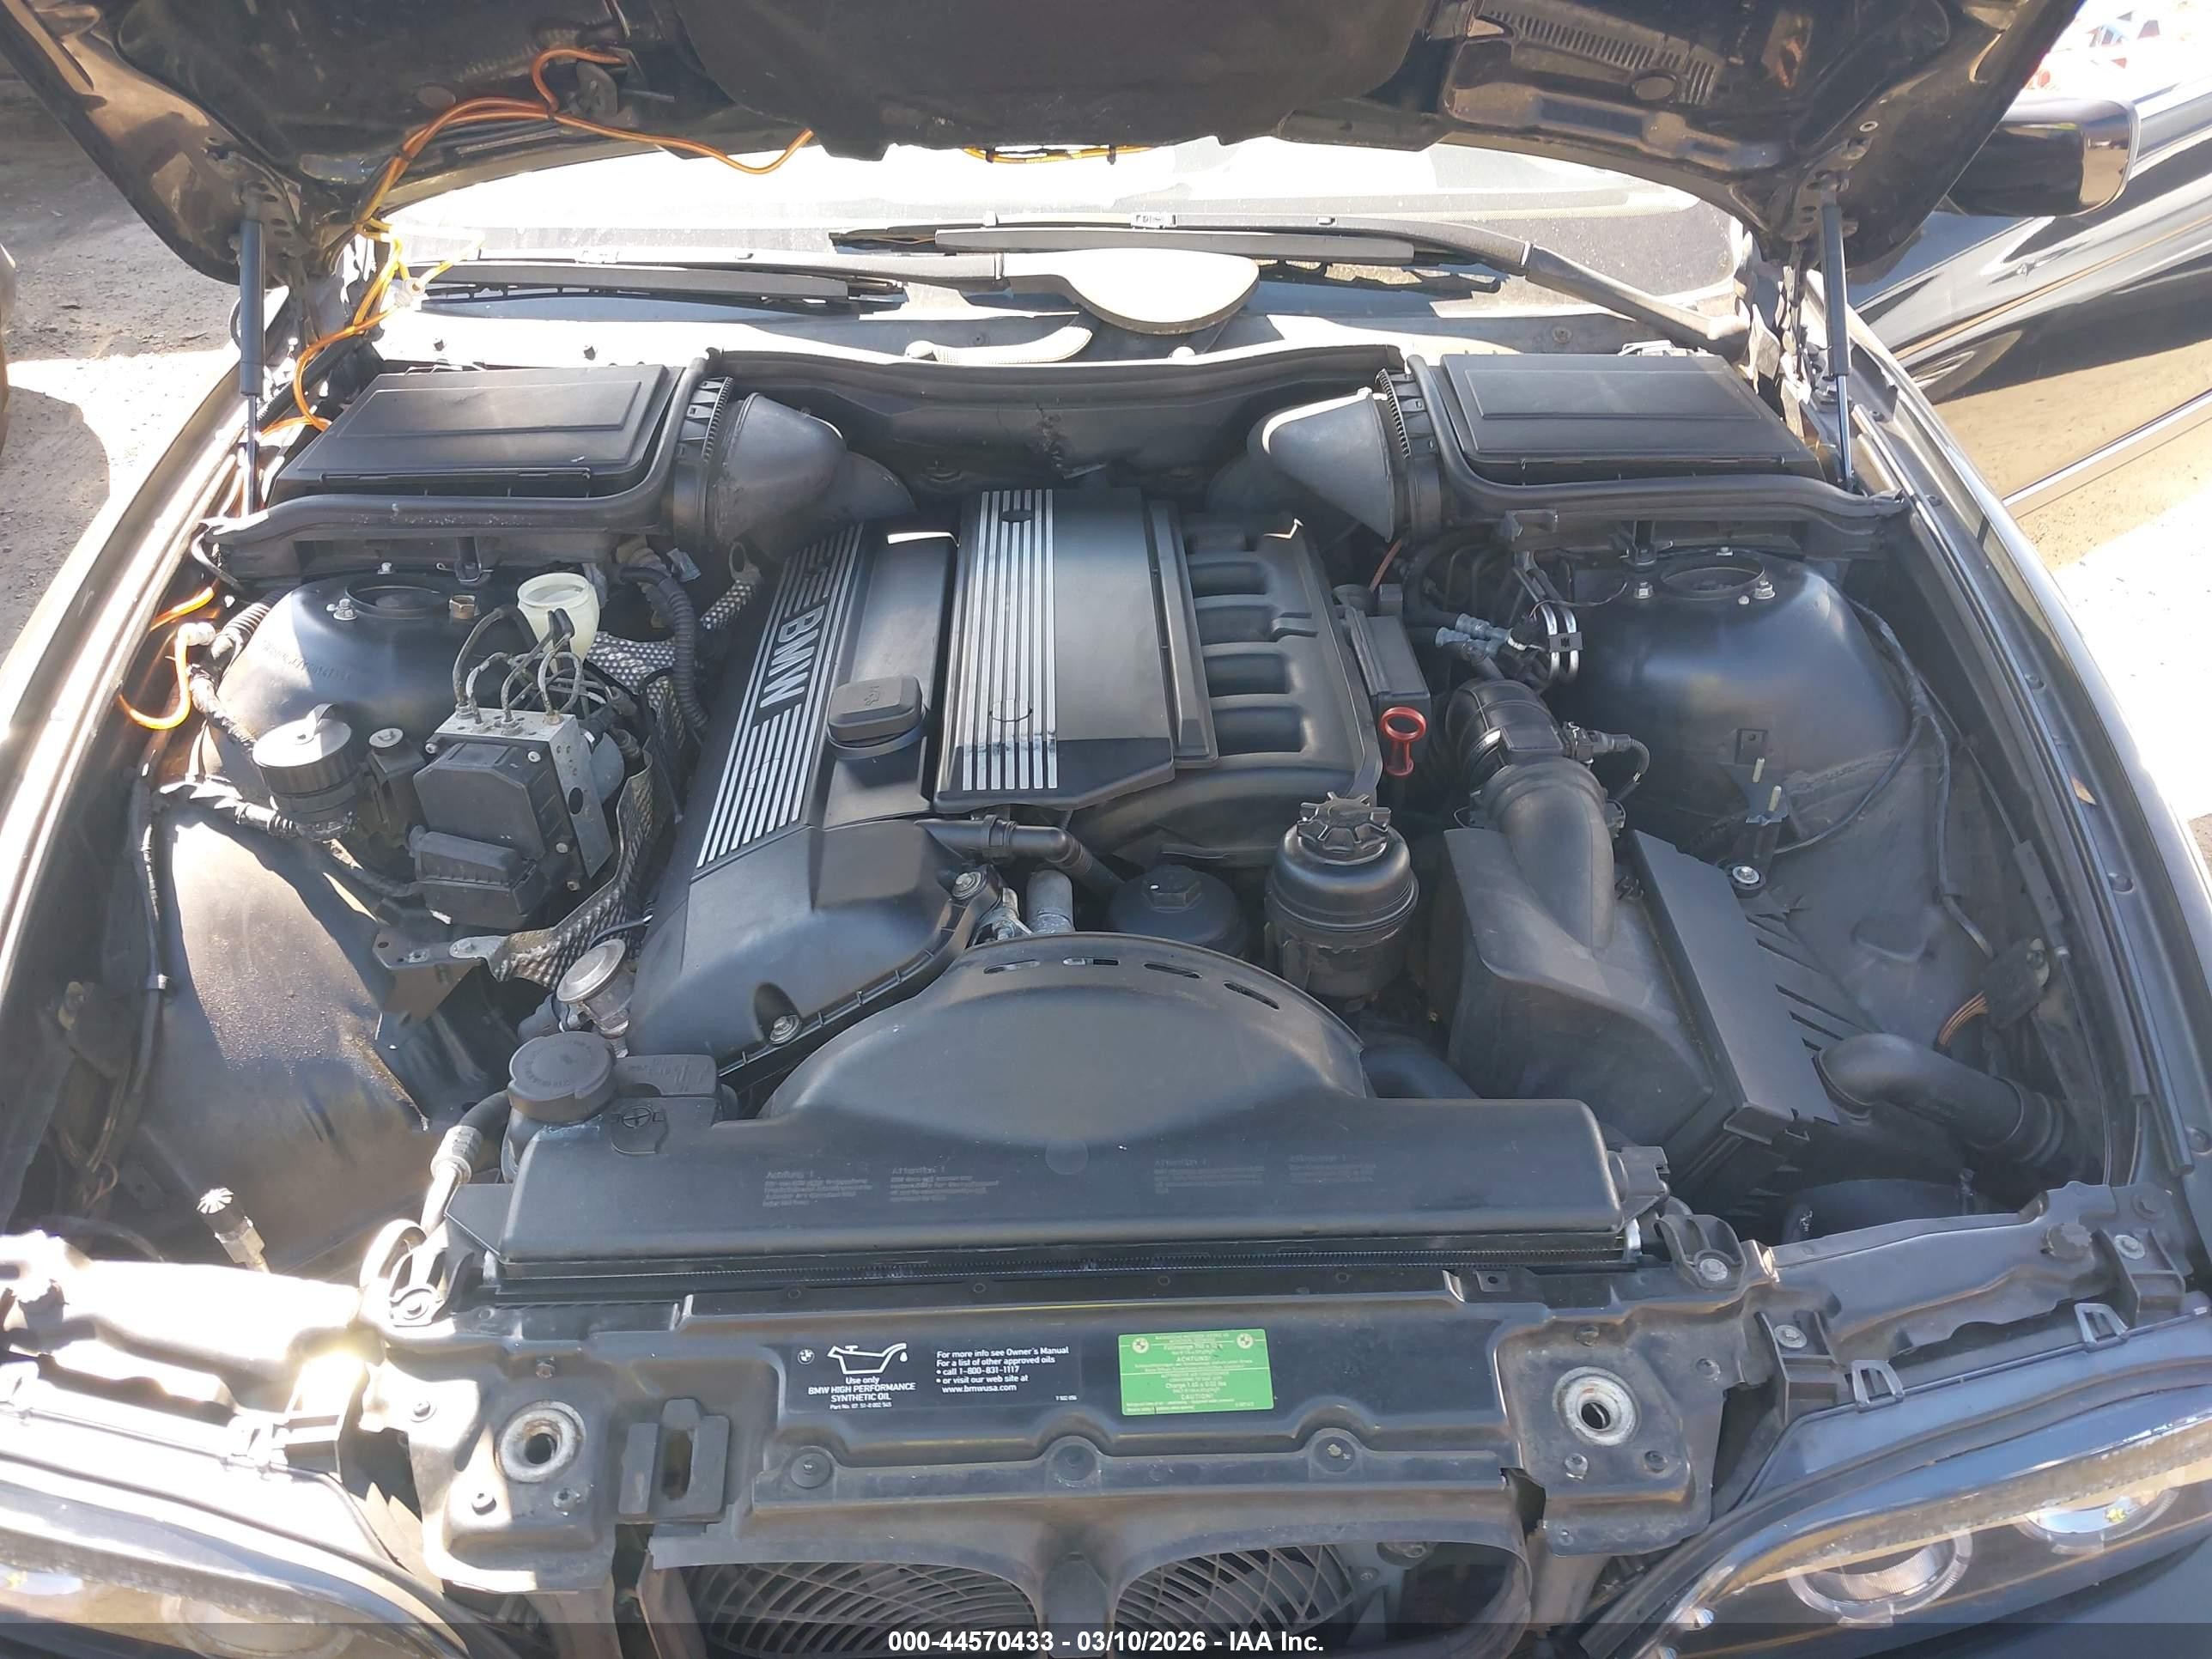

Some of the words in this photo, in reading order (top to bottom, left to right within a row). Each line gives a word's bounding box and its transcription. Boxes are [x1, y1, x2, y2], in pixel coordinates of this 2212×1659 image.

[760, 605, 825, 708] BMW
[1040, 1346, 1069, 1354] Manual
[981, 1357, 1002, 1365] other
[1003, 1355, 1040, 1365] approved
[1041, 1355, 1055, 1364] oils
[959, 1366, 1020, 1375] 1-800-831-1117
[862, 1376, 880, 1385] only
[1004, 1374, 1019, 1382] site
[808, 1387, 830, 1395] BMW
[830, 1385, 852, 1394] HIGH
[853, 1382, 916, 1393] PERFORMANCE
[942, 1384, 1017, 1394] www.bmwusa.com
[830, 1393, 877, 1402] SYNTHETIC
[878, 1392, 891, 1401] OIL
